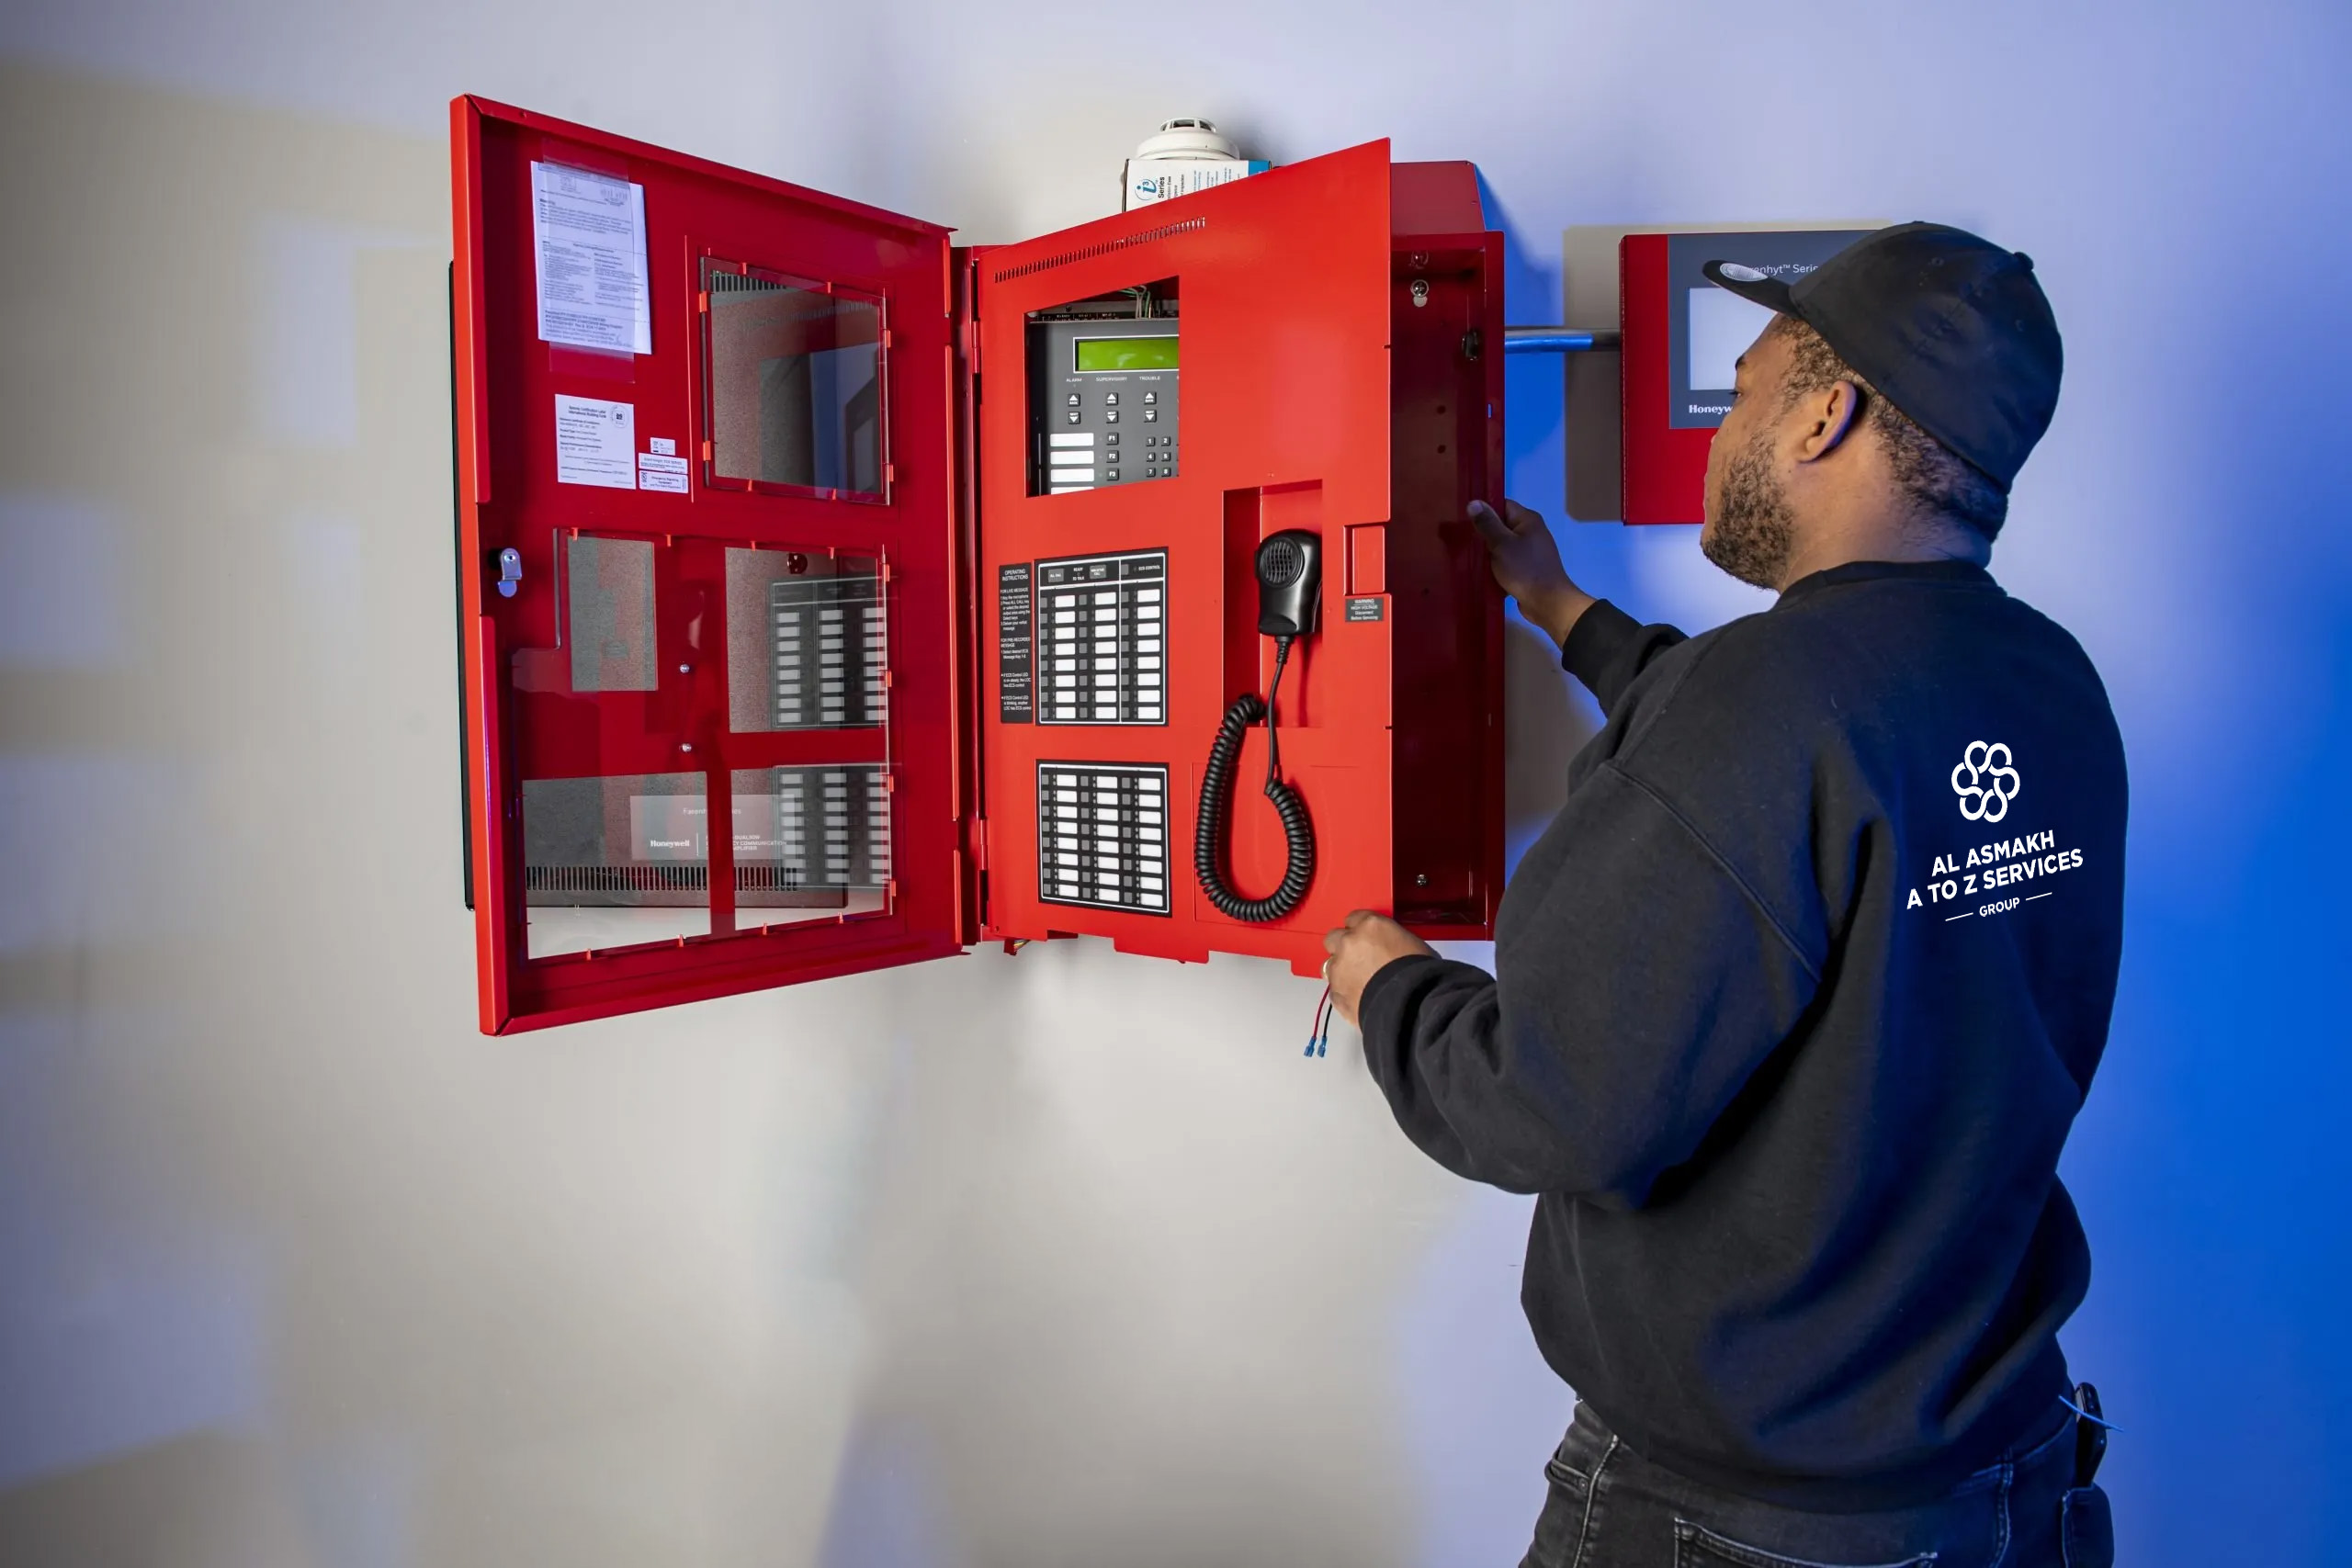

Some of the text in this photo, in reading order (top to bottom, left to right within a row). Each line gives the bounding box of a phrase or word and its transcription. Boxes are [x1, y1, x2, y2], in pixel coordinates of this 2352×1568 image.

[1689, 404, 1733, 414] Honeyw
[650, 840, 690, 848] Honeywell
[1931, 829, 2055, 876] AL ASMAKH
[1906, 848, 2084, 910] A TO Z SERVICES
[1979, 897, 2020, 917] GROUP
